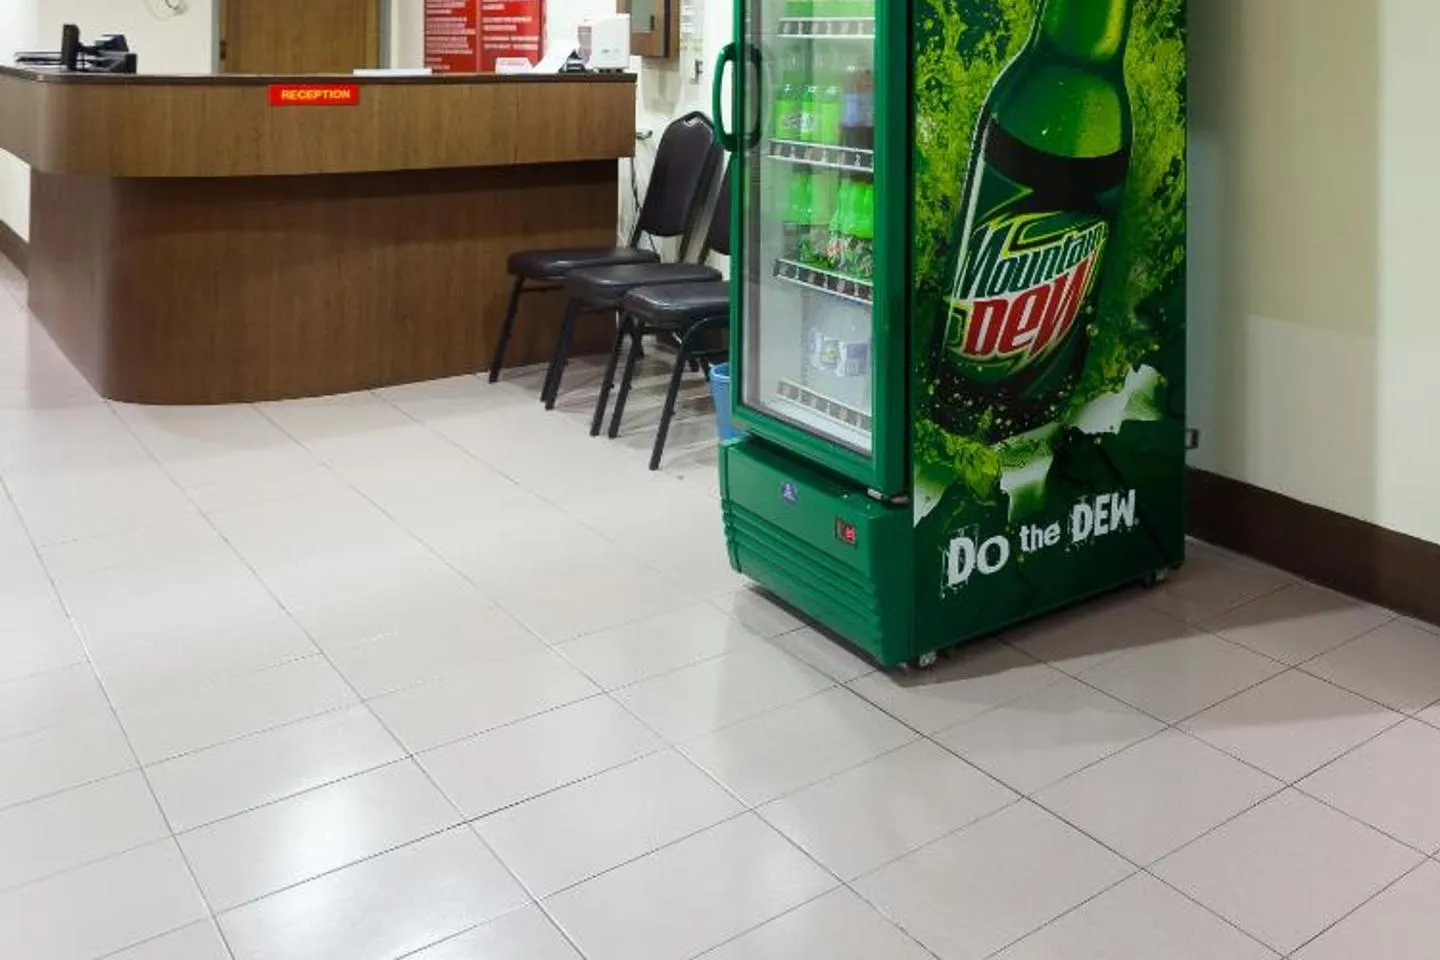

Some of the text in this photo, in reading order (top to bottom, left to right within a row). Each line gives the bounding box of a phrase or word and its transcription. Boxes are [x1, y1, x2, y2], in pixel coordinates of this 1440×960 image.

[281, 88, 351, 101] RECEPTION
[953, 221, 1106, 300] Mountain
[1019, 522, 1061, 552] the
[1072, 489, 1136, 542] DEW
